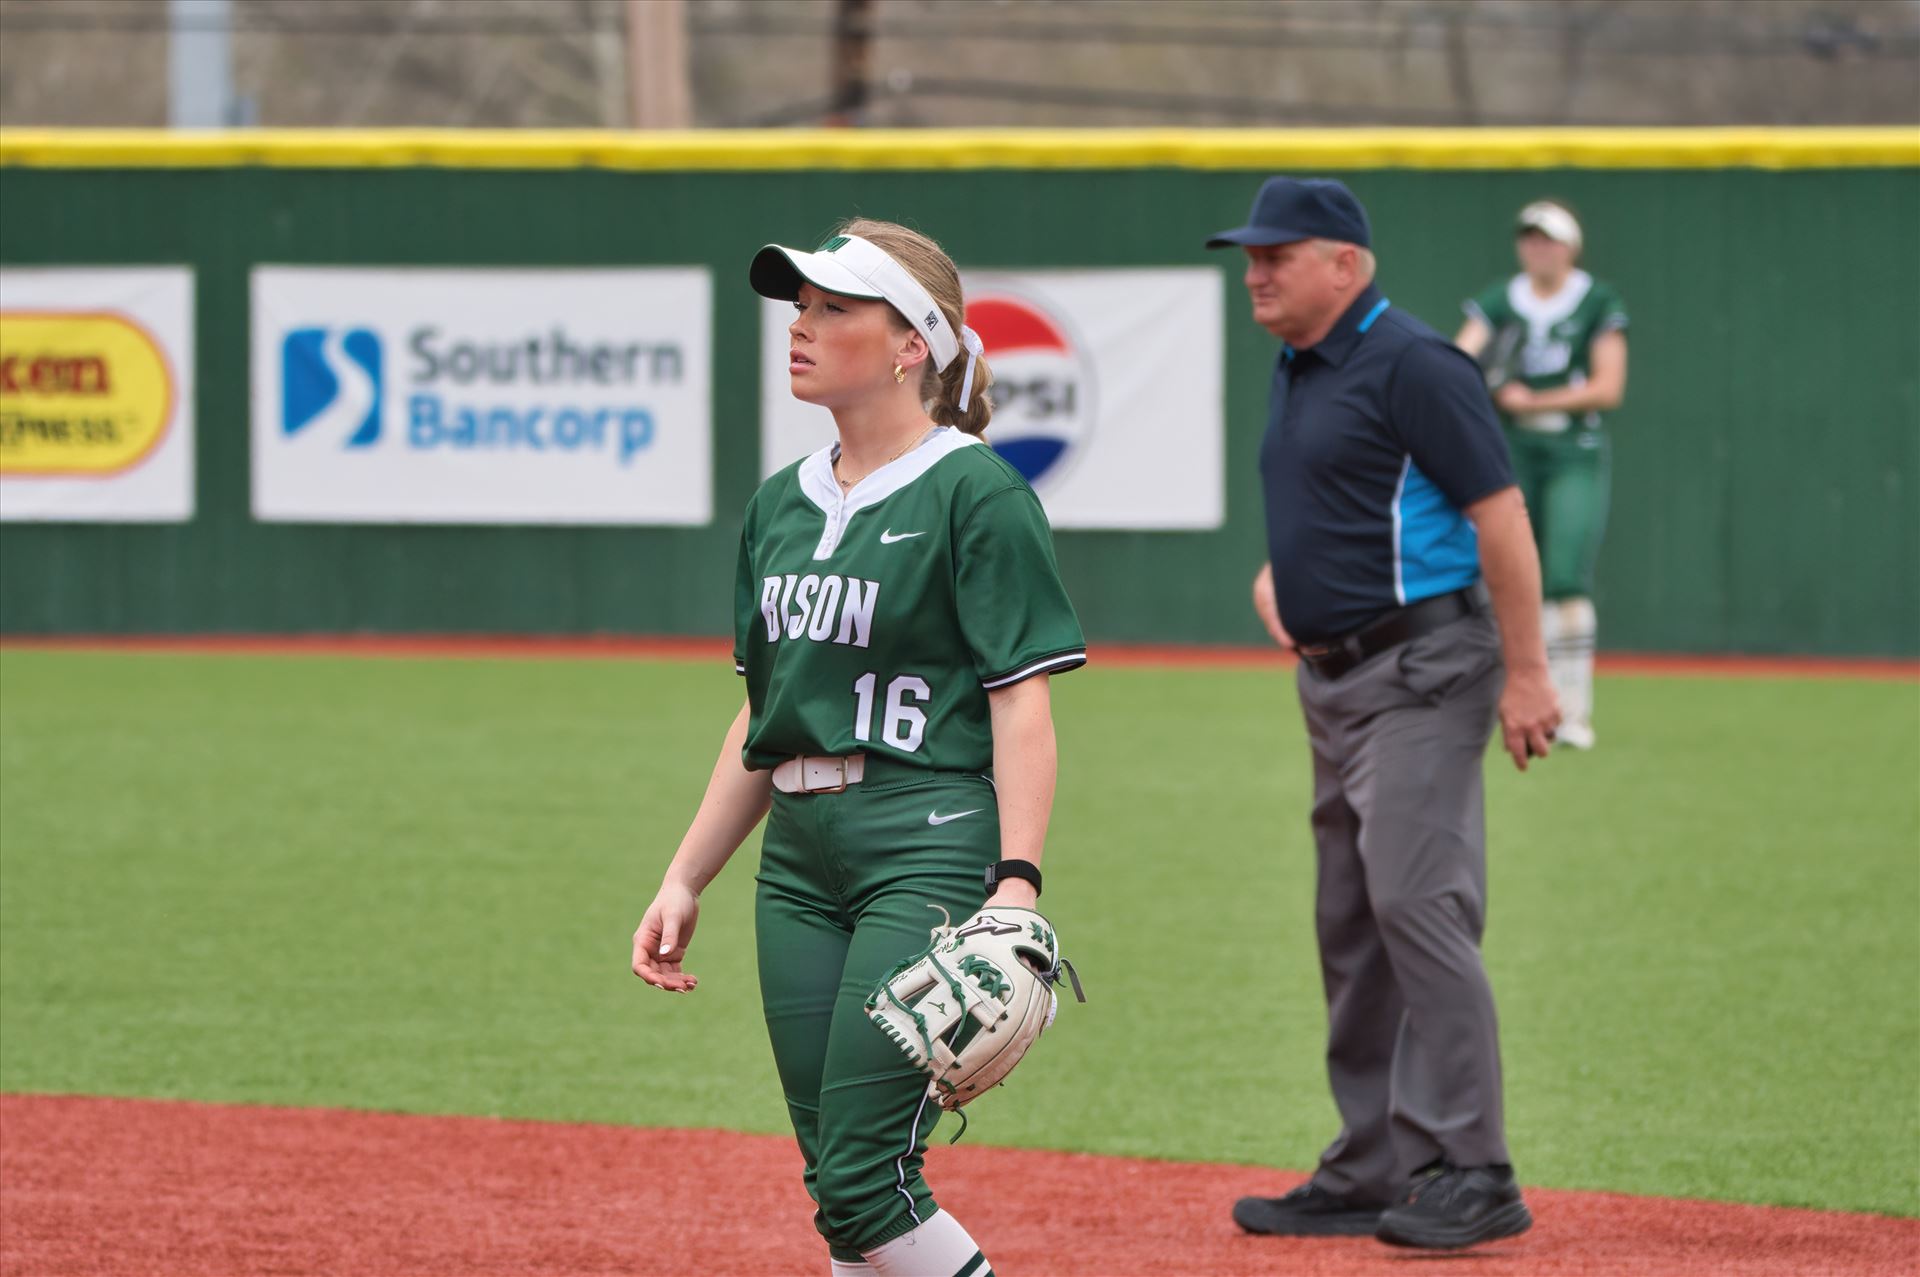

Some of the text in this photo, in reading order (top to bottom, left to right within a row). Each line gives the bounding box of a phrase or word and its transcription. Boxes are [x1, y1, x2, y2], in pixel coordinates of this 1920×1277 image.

[410, 326, 684, 383] Southern
[407, 394, 656, 465] Bancorp
[988, 378, 1077, 418] PSI
[760, 573, 881, 649] BISON
[853, 671, 933, 753] 16
